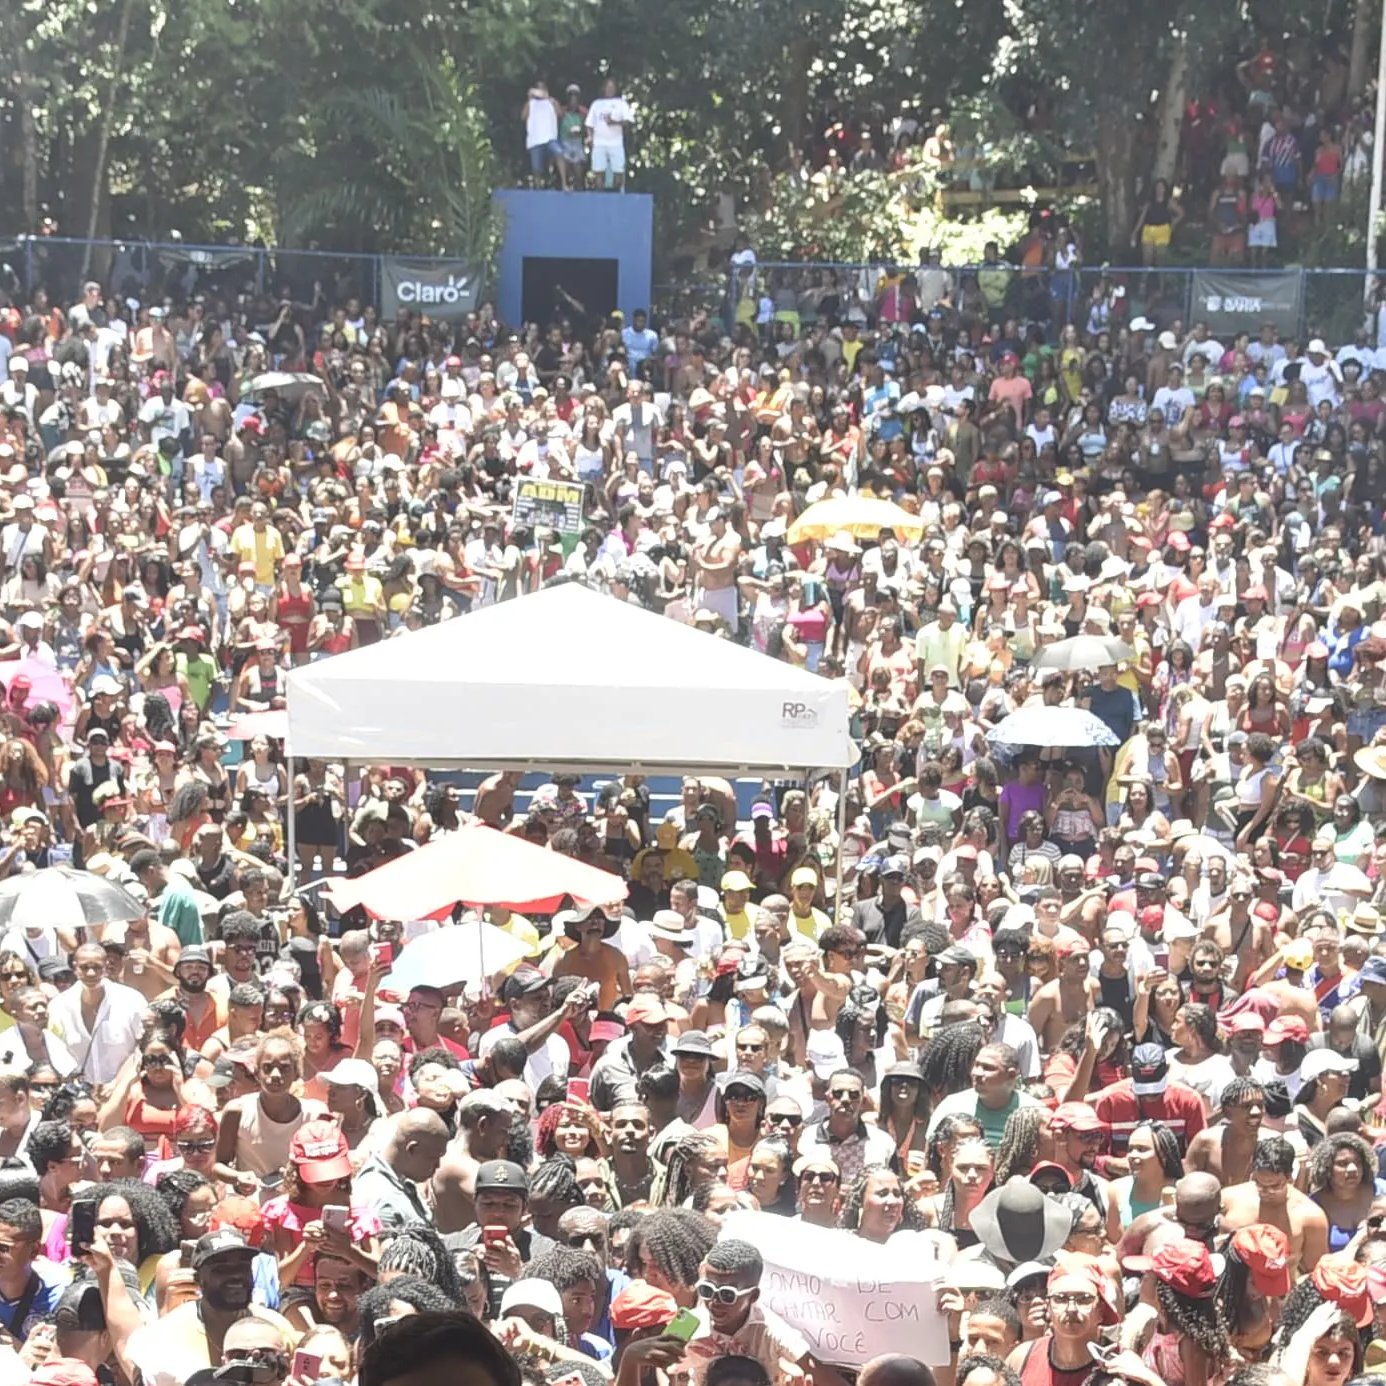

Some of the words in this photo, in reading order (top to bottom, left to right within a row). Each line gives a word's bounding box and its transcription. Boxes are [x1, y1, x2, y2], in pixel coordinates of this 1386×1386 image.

[397, 280, 459, 303] Claro
[856, 1277, 892, 1294] DE
[865, 1301, 919, 1322] COM
[803, 1327, 866, 1354] VOCÊ
